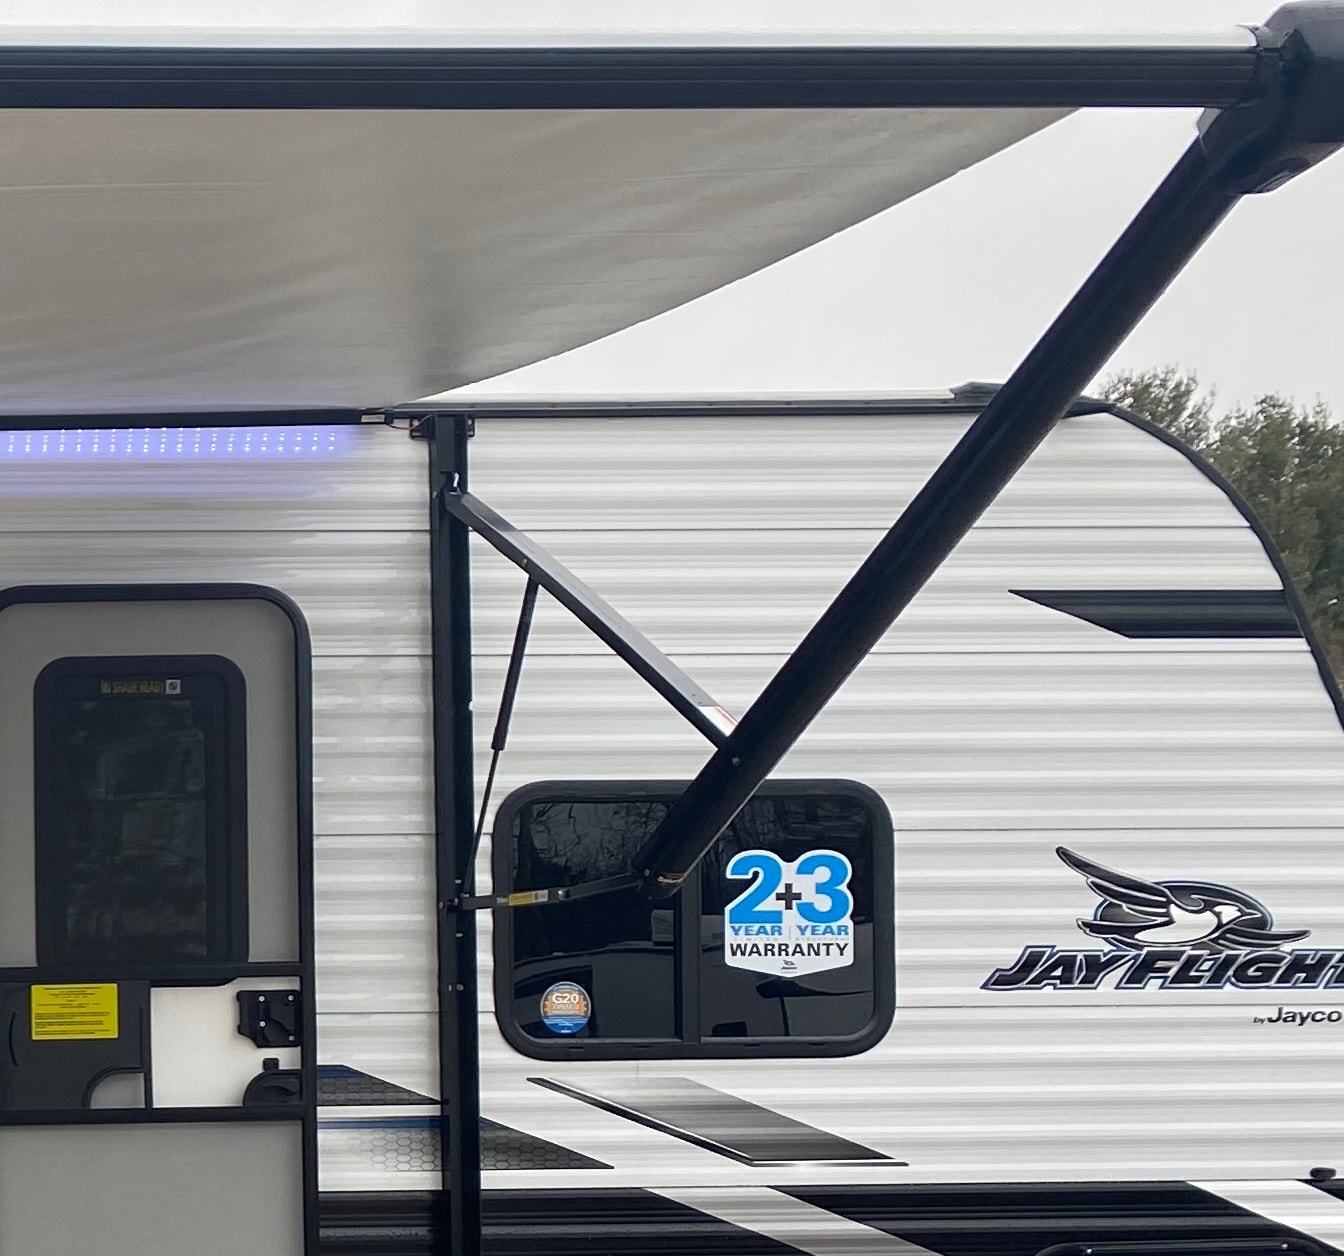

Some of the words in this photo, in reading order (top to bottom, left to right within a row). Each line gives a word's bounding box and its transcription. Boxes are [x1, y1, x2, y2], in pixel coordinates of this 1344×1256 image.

[729, 925, 783, 936] YEAR
[796, 925, 850, 936] YEAR
[729, 942, 850, 957] WARRANTY
[980, 945, 1128, 990] JAY
[552, 992, 580, 1004] G20
[1267, 1007, 1343, 1026] Jayco
